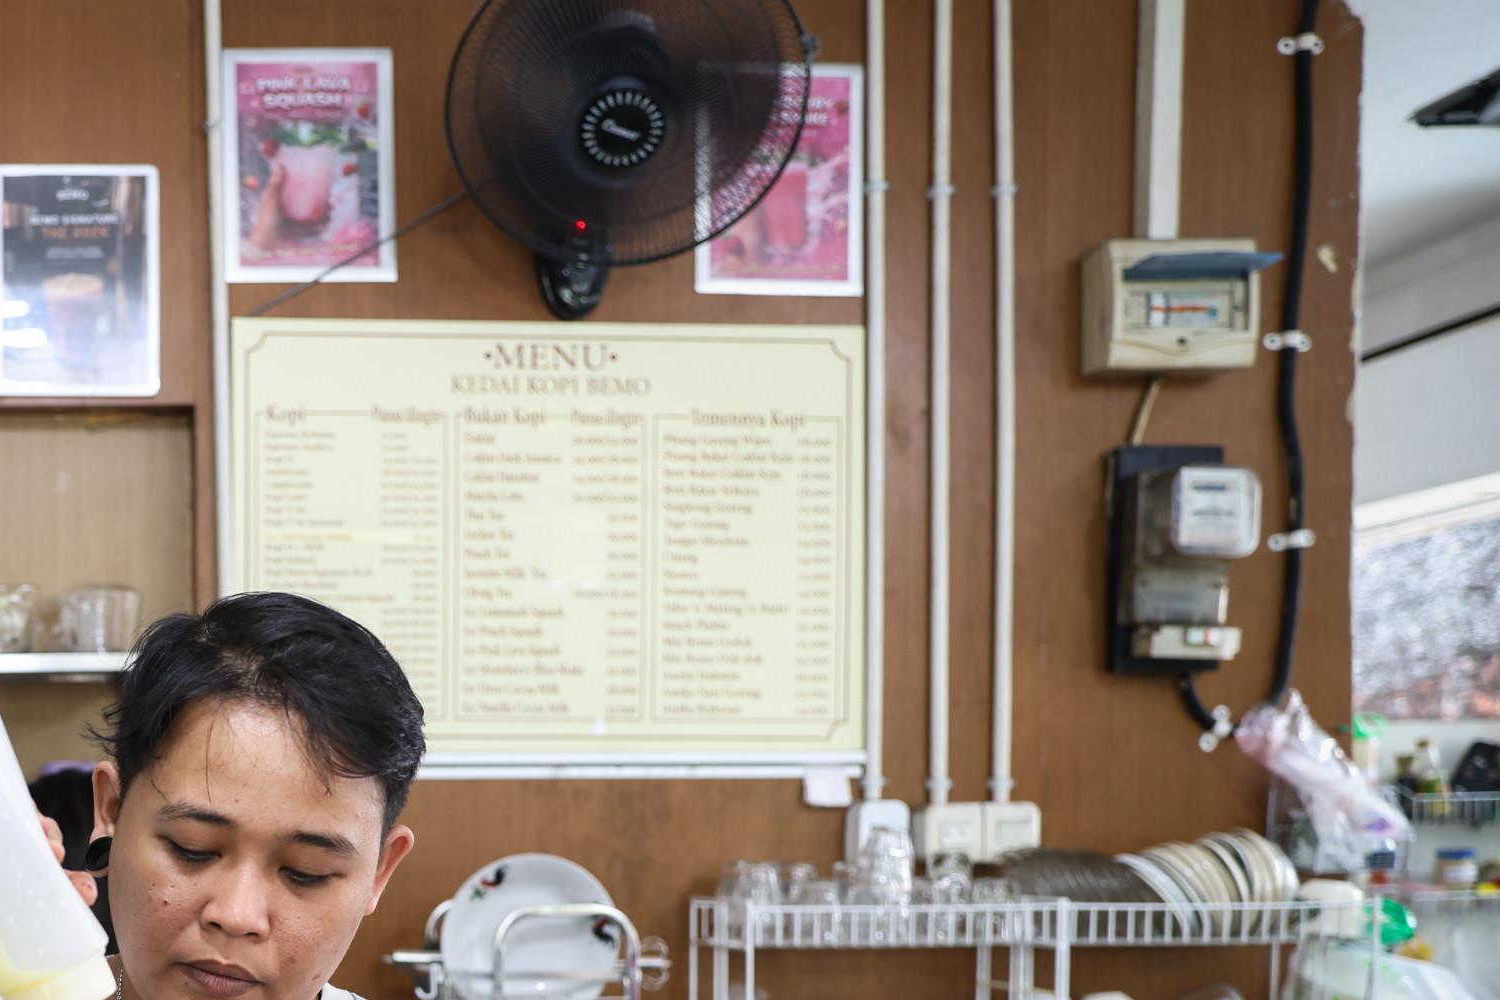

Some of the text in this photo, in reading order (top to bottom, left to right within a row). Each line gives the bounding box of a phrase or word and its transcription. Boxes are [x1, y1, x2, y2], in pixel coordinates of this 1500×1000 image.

[263, 93, 342, 110] SQUASH
[493, 343, 608, 371] MENU
[451, 376, 652, 397] KEDAI KOPI BEMO
[266, 405, 306, 427] Kopi
[465, 406, 546, 431] Bukan Kopi
[769, 409, 806, 432] Kopi
